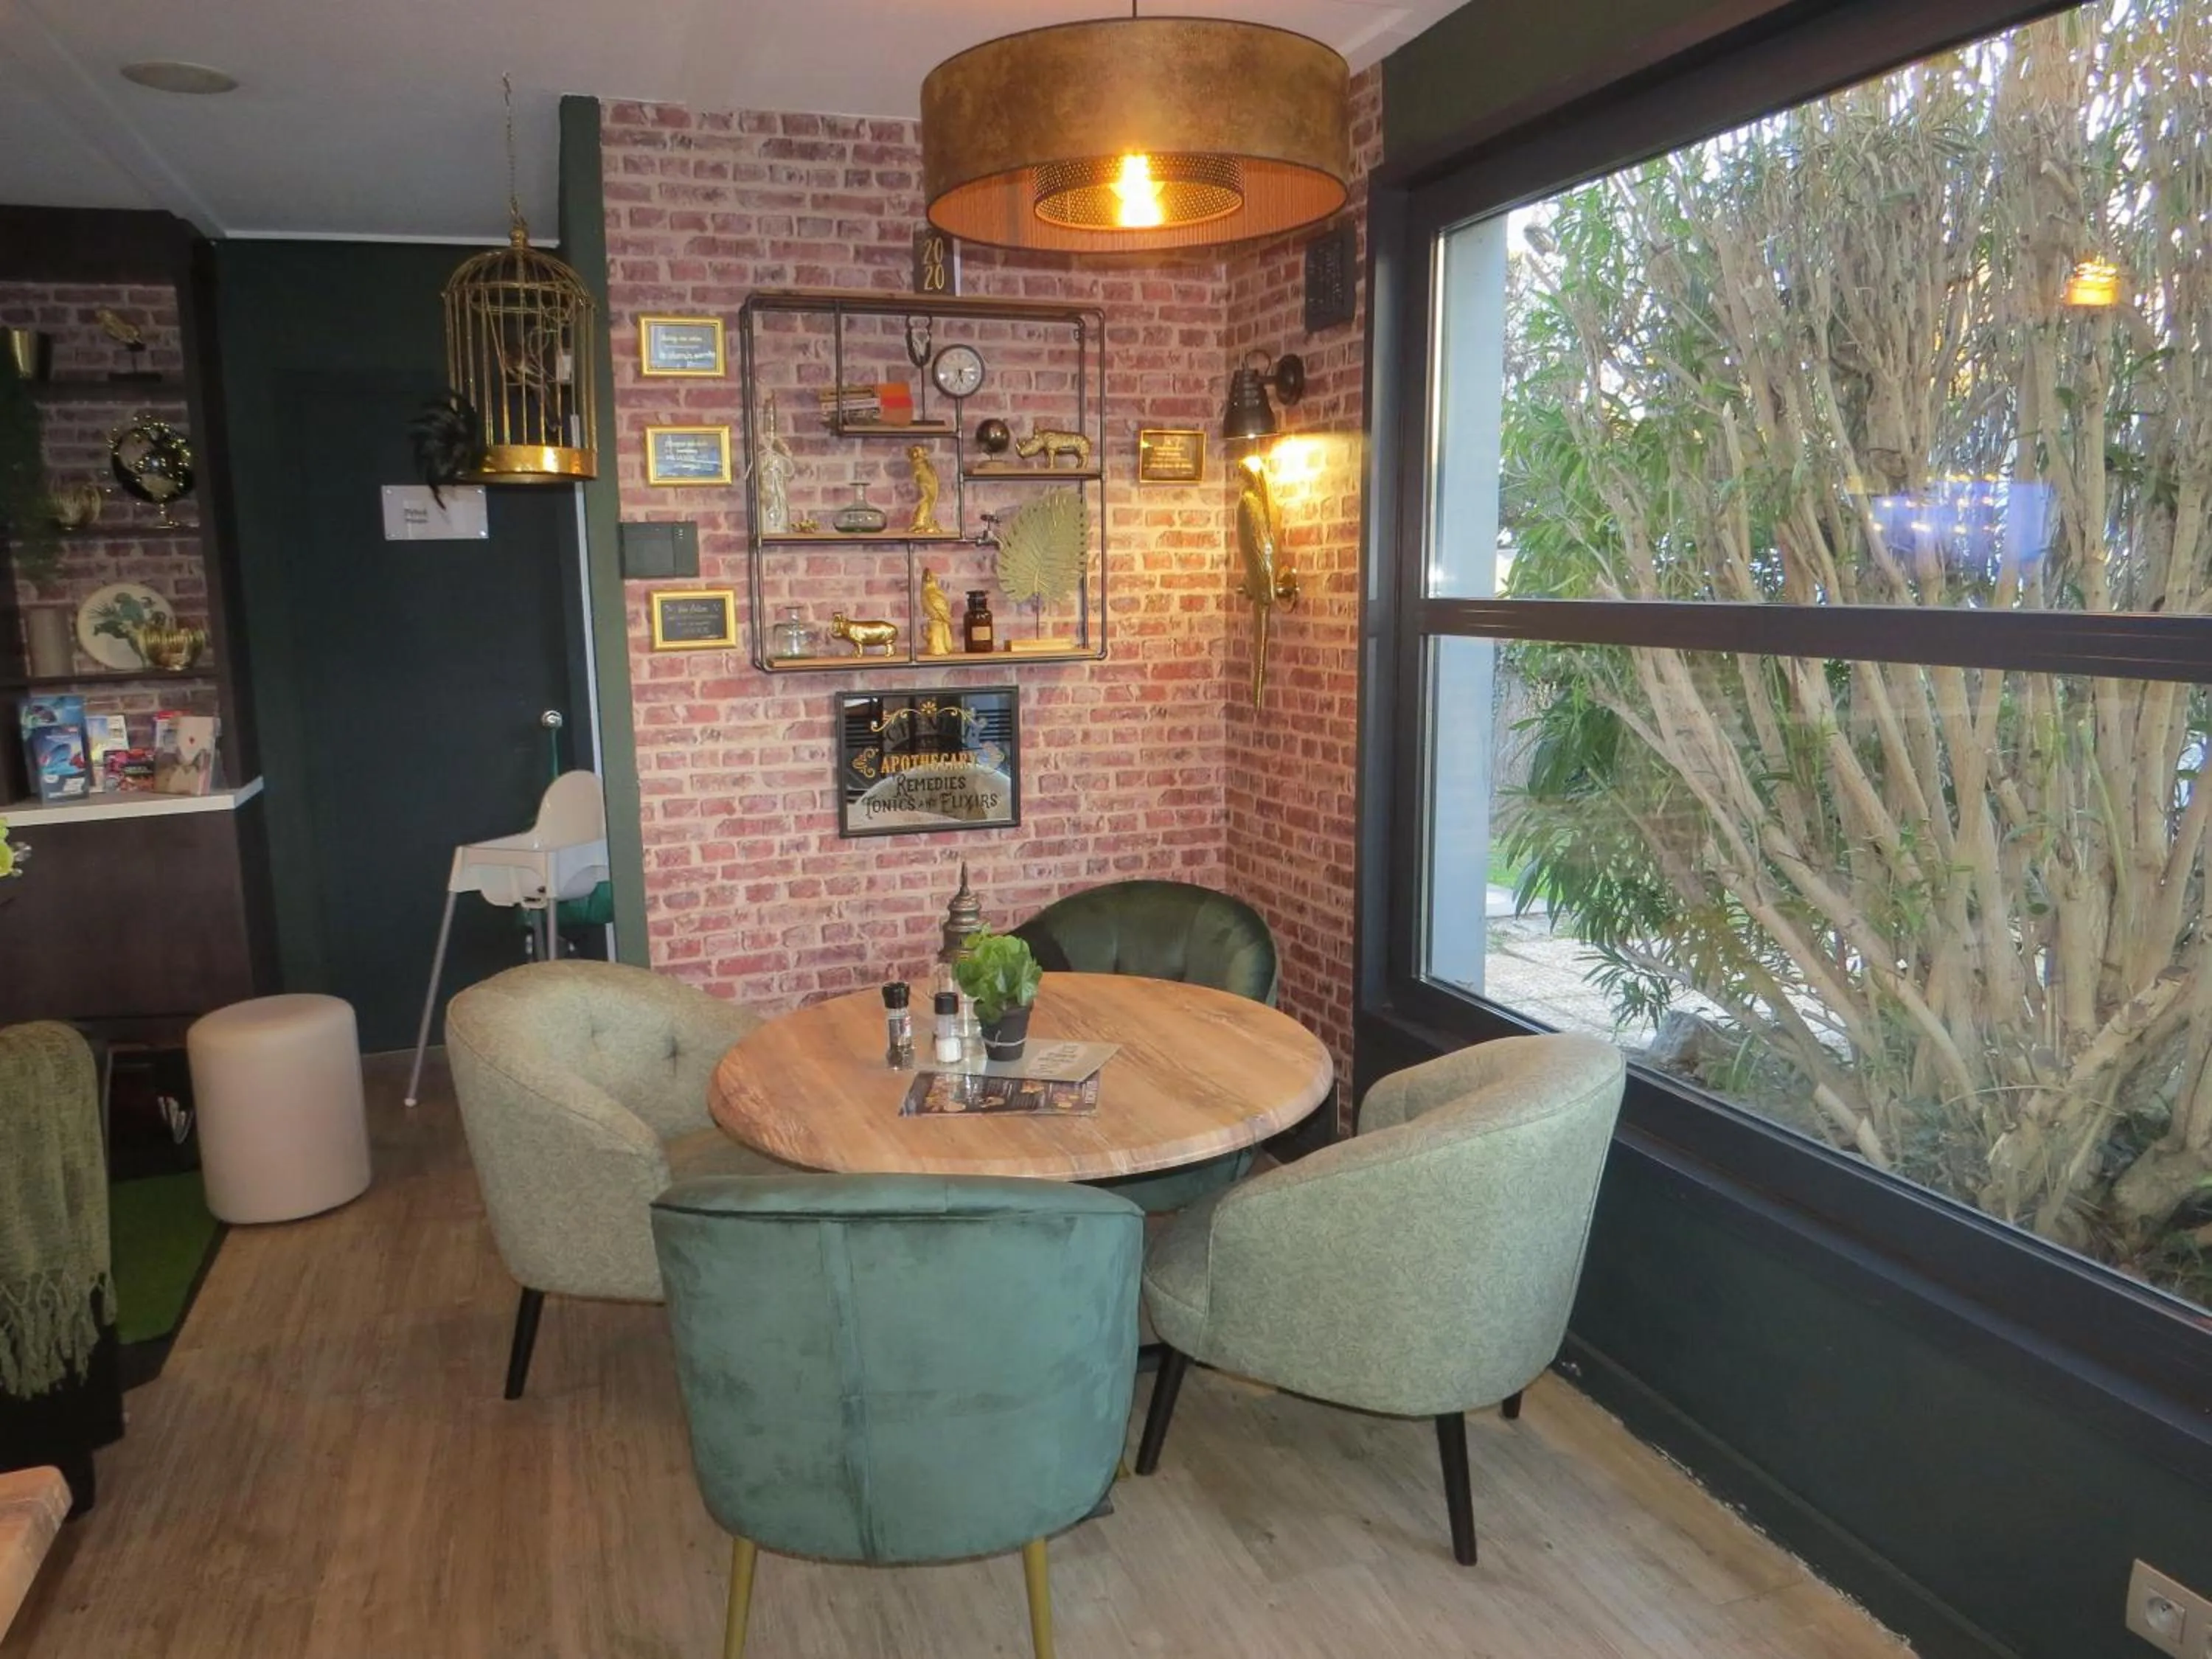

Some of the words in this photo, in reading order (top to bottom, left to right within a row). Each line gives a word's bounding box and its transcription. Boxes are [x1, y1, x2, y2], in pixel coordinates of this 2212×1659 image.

[923, 237, 943, 264] 20
[924, 264, 945, 290] 20
[880, 753, 975, 773] APOTHECARY
[895, 774, 966, 797] REMEDIES
[862, 796, 914, 818] TONICS
